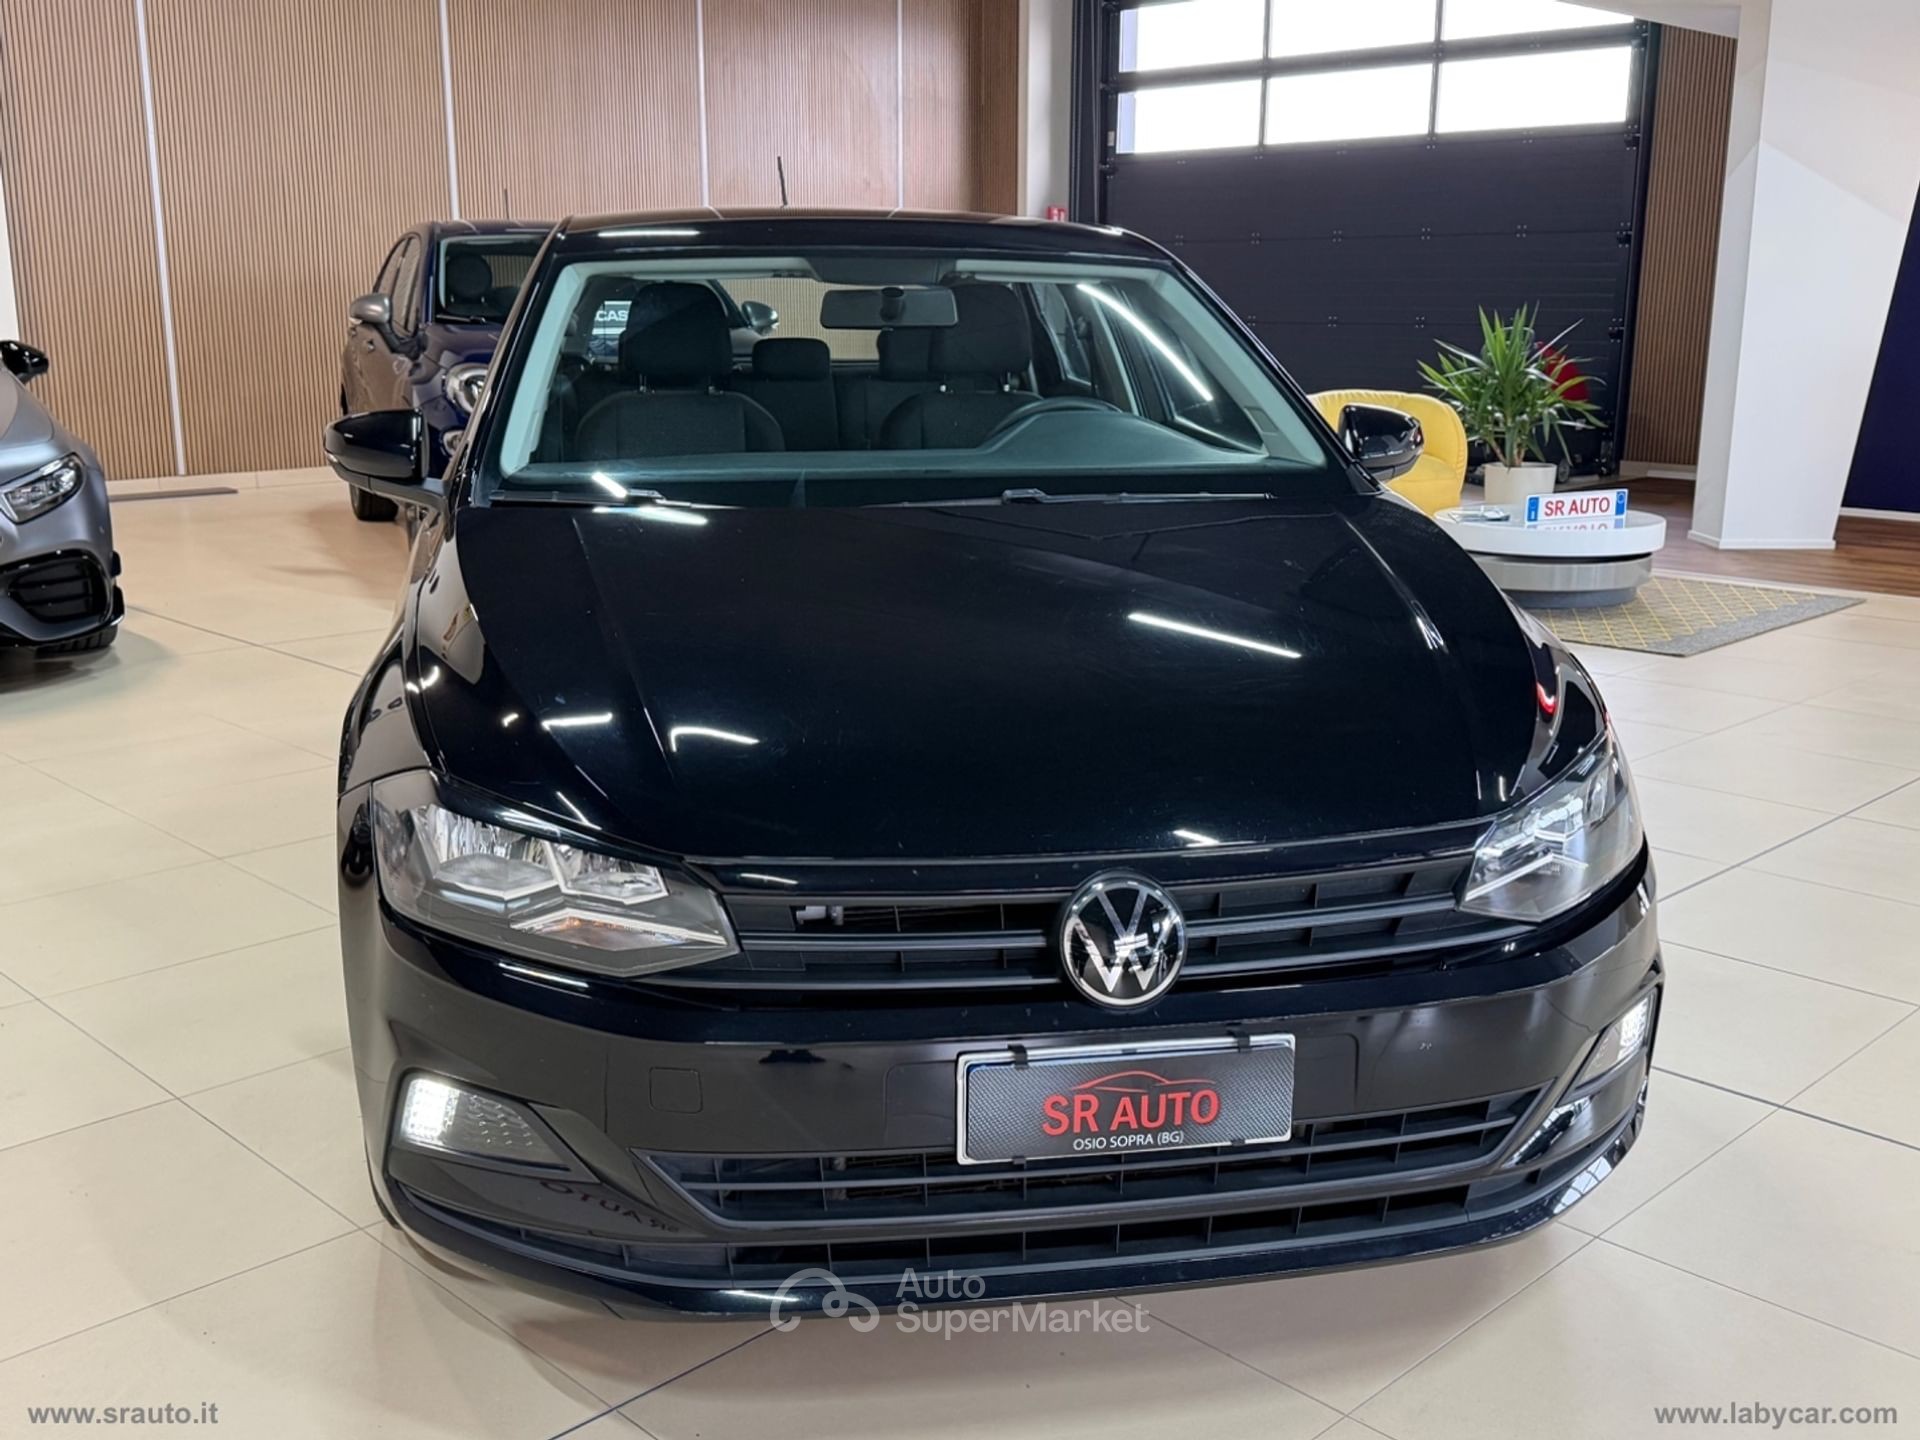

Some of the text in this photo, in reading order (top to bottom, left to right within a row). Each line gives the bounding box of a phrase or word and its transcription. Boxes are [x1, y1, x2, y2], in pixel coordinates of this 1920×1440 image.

[1544, 496, 1611, 517] SR AUTO
[1042, 1089, 1221, 1136] SR AUTO
[1072, 1130, 1184, 1151] OSIO SOPRA (BG)
